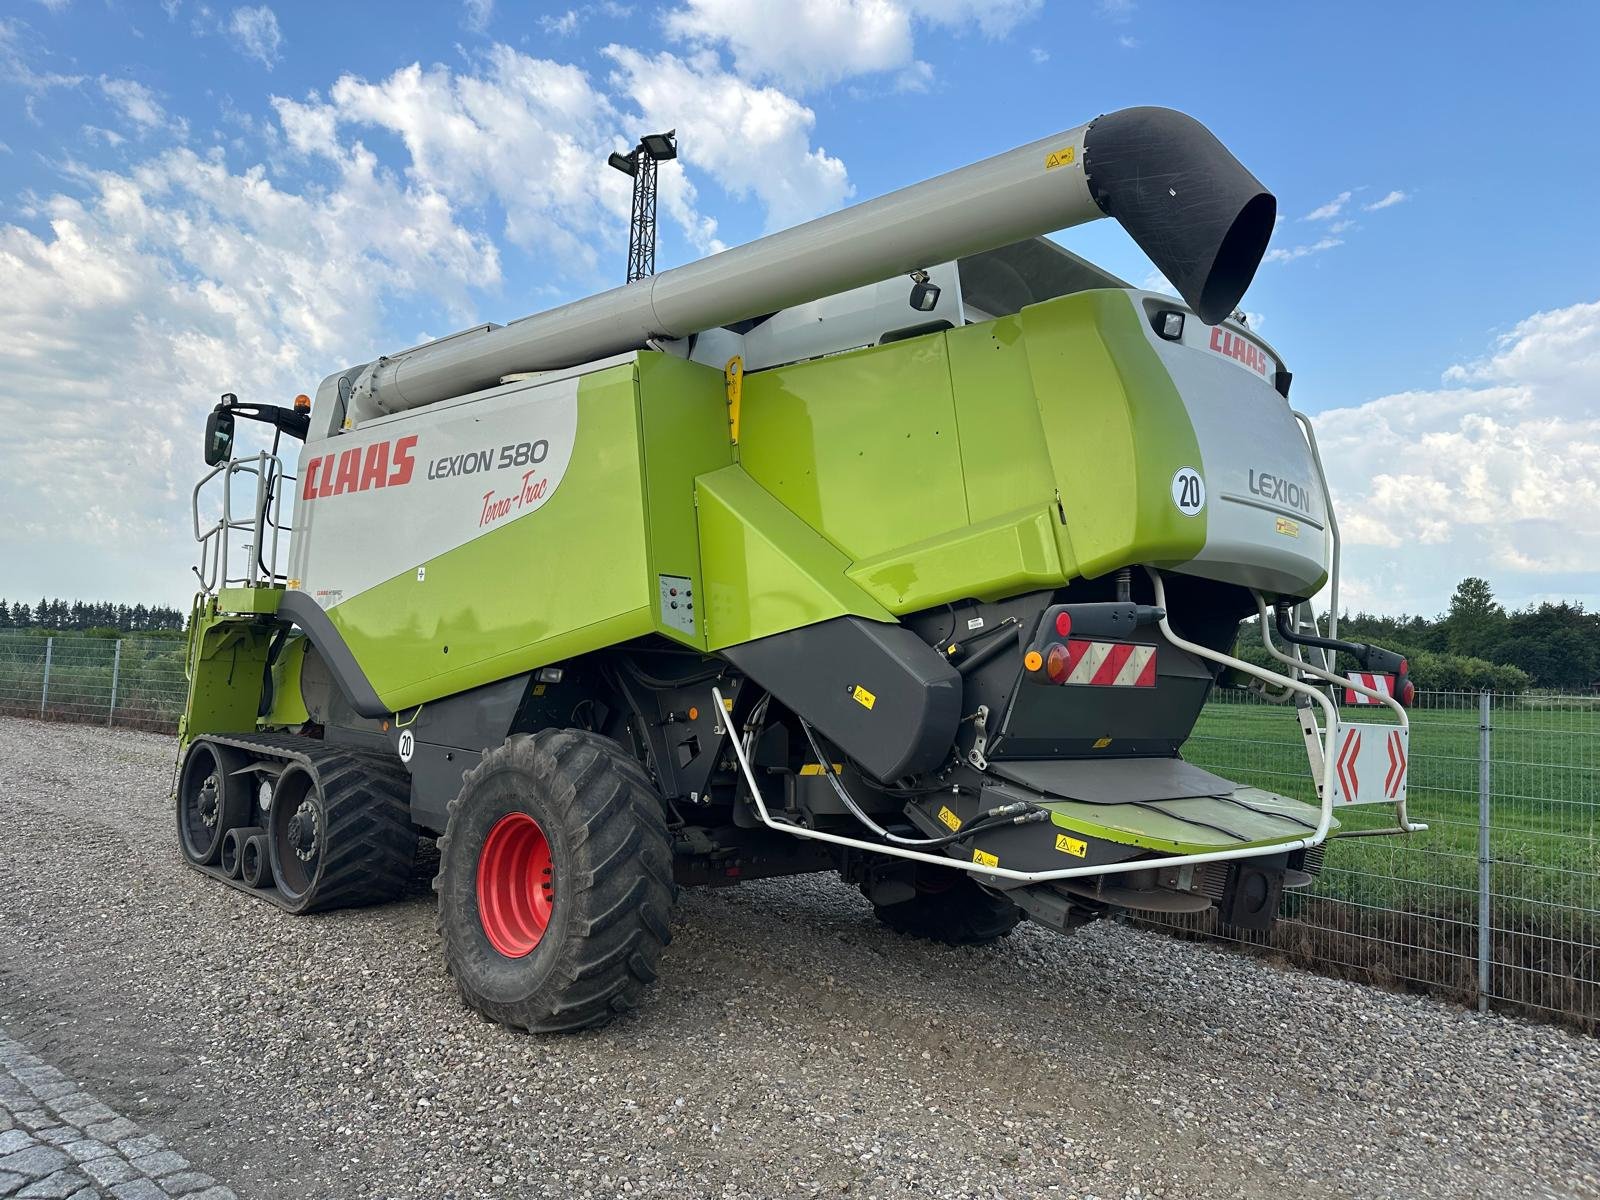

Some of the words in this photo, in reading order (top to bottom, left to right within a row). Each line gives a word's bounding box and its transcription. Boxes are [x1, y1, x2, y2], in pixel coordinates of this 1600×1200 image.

[1209, 326, 1266, 376] CLAAS
[303, 434, 419, 501] CLAAS
[427, 448, 495, 481] LEXION
[497, 439, 549, 470] 580
[479, 469, 548, 528] Terra-Trac
[1178, 474, 1201, 508] 20
[1249, 468, 1310, 514] LEXION
[401, 735, 411, 757] 20
